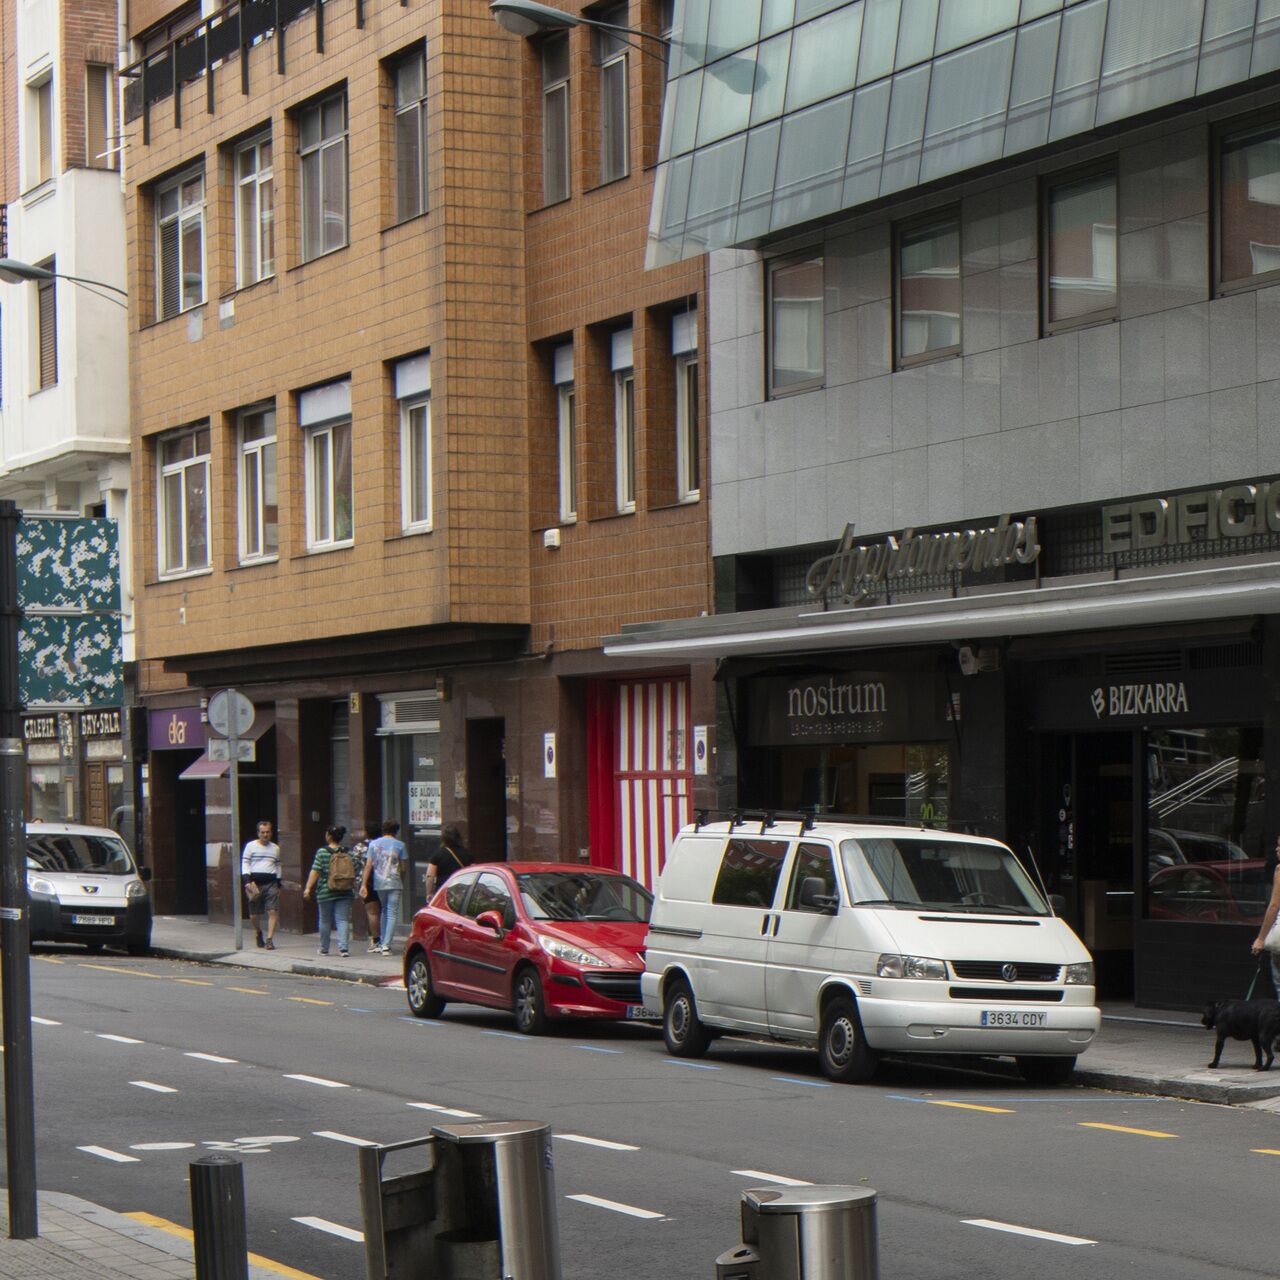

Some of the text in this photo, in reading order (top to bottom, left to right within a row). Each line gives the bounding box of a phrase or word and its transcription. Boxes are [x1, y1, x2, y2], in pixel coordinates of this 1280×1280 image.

[806, 513, 1041, 600] Apartamentos
[787, 677, 887, 717] nostrum
[1109, 682, 1189, 715] BIZKARRA
[989, 1012, 1045, 1026] 3634 CDY
